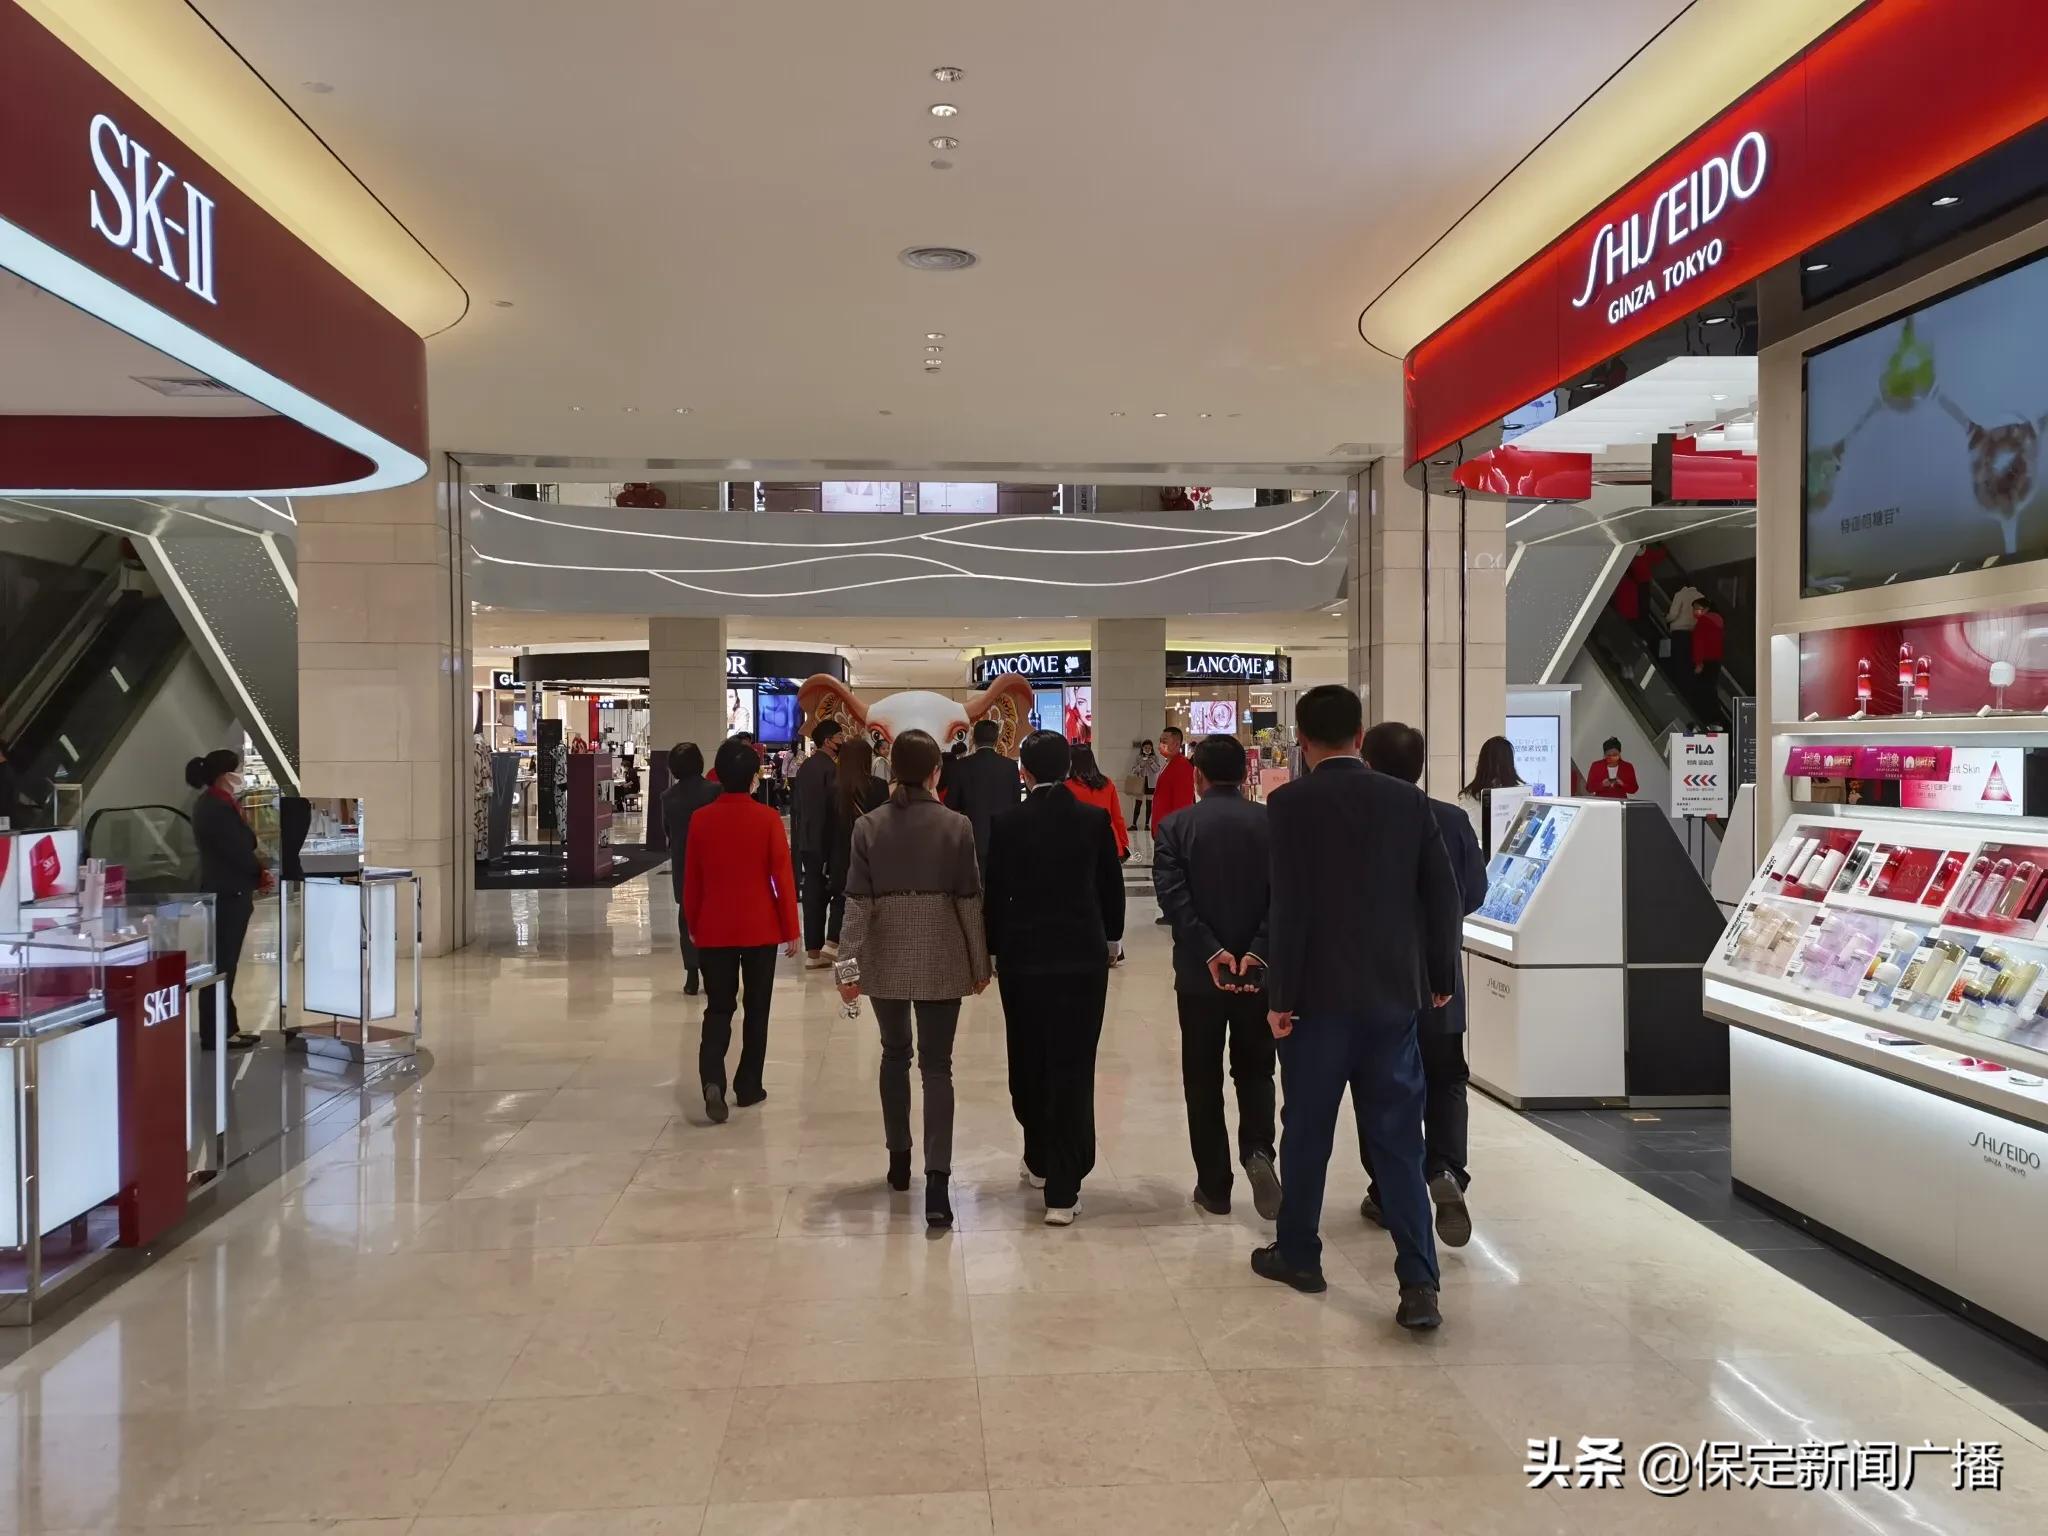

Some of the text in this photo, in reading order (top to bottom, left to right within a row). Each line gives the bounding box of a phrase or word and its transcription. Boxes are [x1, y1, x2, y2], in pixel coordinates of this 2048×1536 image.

[89, 113, 217, 305] SK-II
[1572, 131, 1767, 307] SHISEIDO
[1608, 238, 1723, 325] GINZA TOKYO
[984, 653, 1059, 676] LANCÔME
[1186, 653, 1262, 674] LANCÔME
[1685, 743, 1715, 755] FILA
[1963, 763, 1981, 774] Skin
[143, 984, 180, 1027] SK-II
[1968, 1131, 2041, 1169] SHISEIDO
